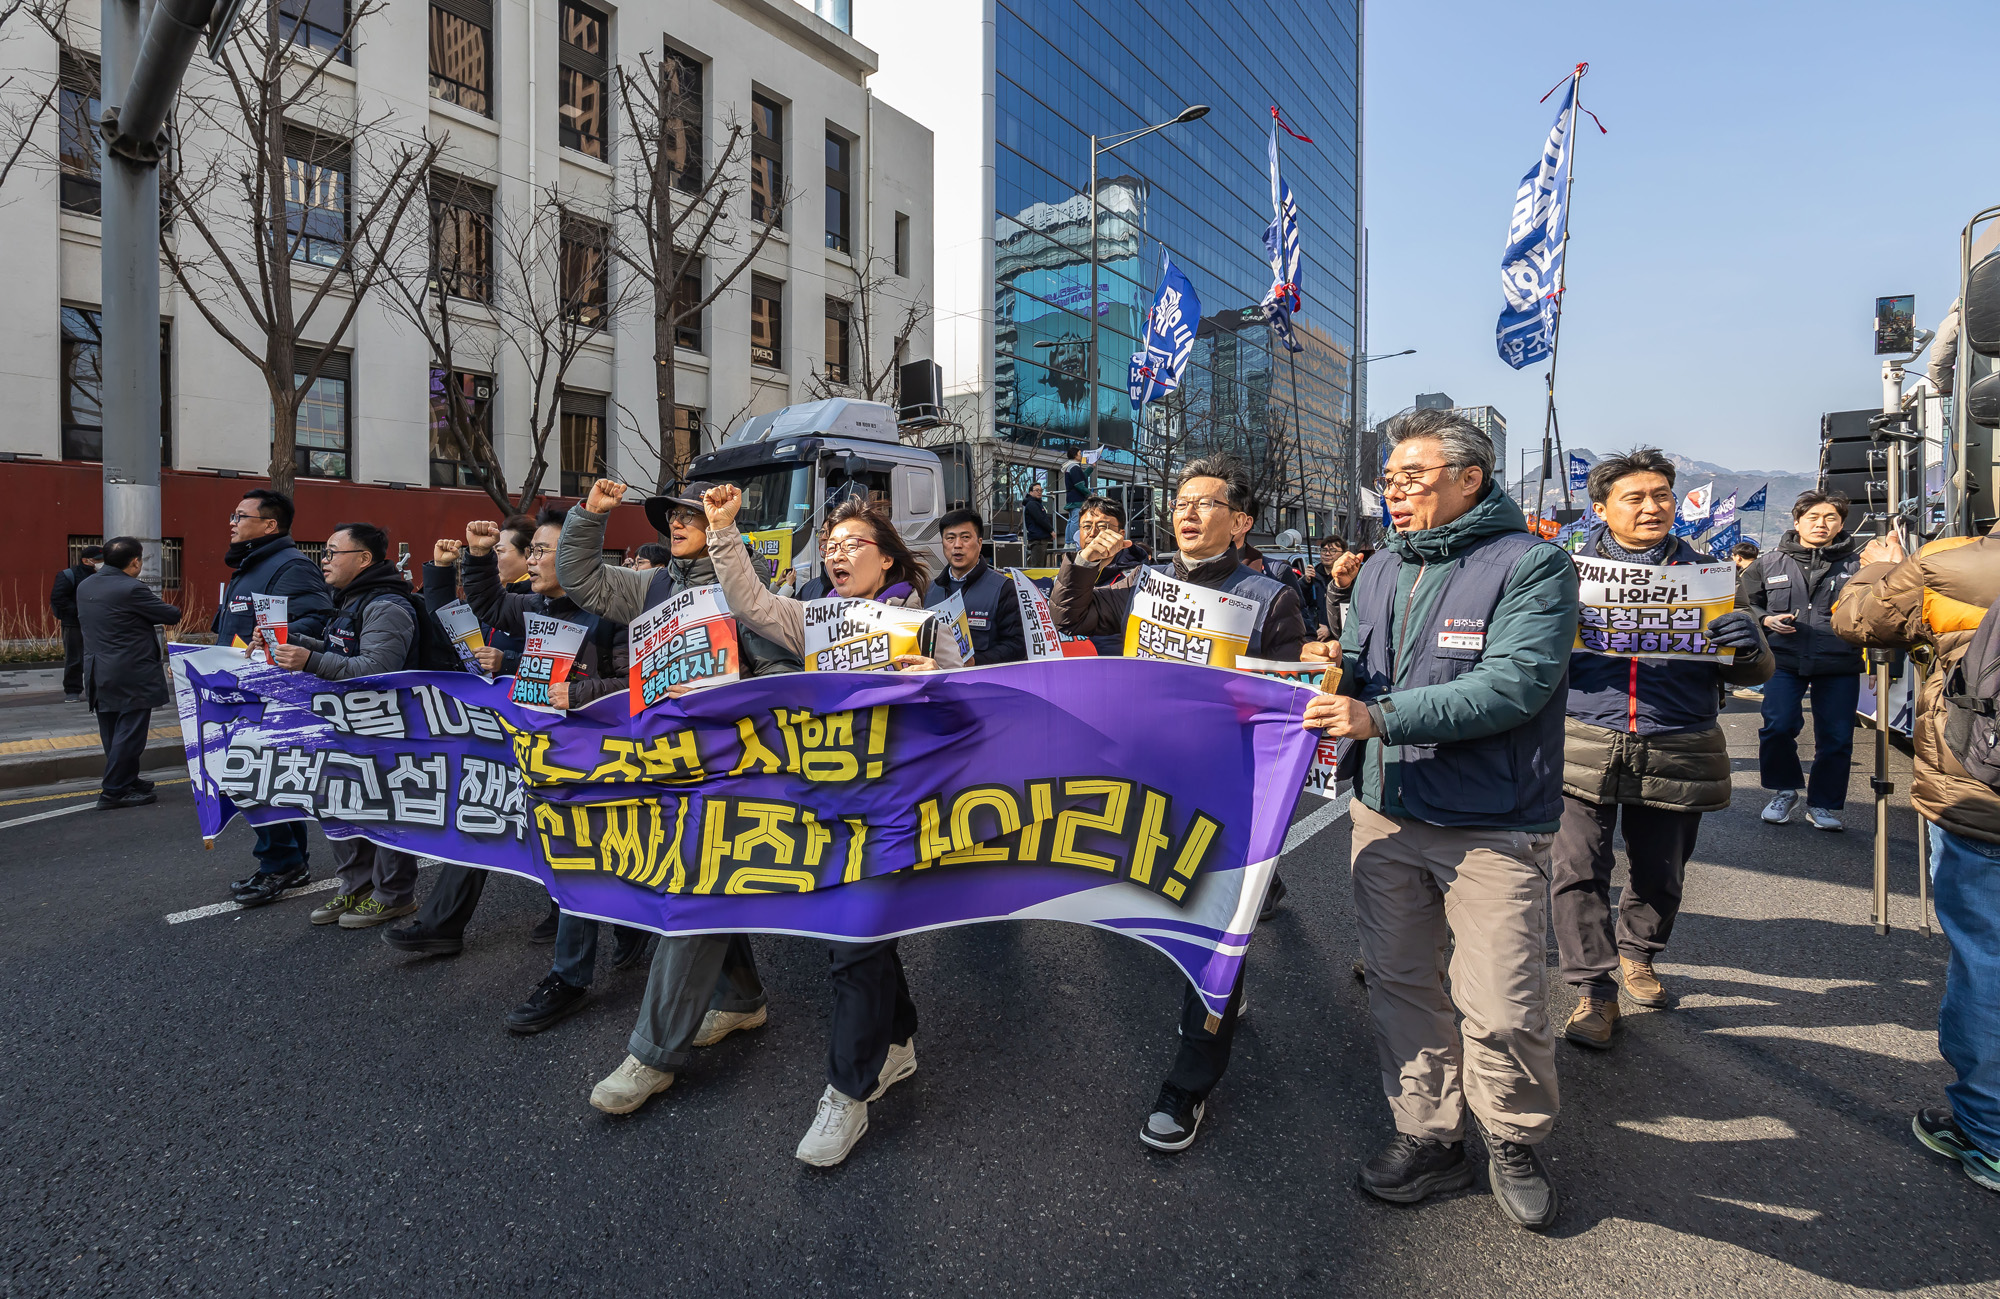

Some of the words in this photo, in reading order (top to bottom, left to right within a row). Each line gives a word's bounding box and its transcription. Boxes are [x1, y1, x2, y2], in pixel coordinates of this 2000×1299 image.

[1138, 571, 1180, 603] 진짜사장
[1605, 584, 1688, 604] 나와라!
[632, 620, 651, 643] 모든
[653, 591, 695, 630] 노동자의
[1019, 590, 1041, 630] 노동자의
[1151, 602, 1205, 630] 나와라!
[1454, 619, 1485, 627] 민주노총
[1580, 607, 1701, 631] 원청교섭
[635, 616, 680, 661] 노동기본권
[641, 625, 710, 679] 투쟁으로
[816, 633, 889, 670] 원청교섭
[1138, 620, 1212, 665] 원청교섭
[642, 649, 726, 705] 쟁취하자!
[728, 704, 891, 782] 시행!
[219, 749, 446, 826] 원청교섭
